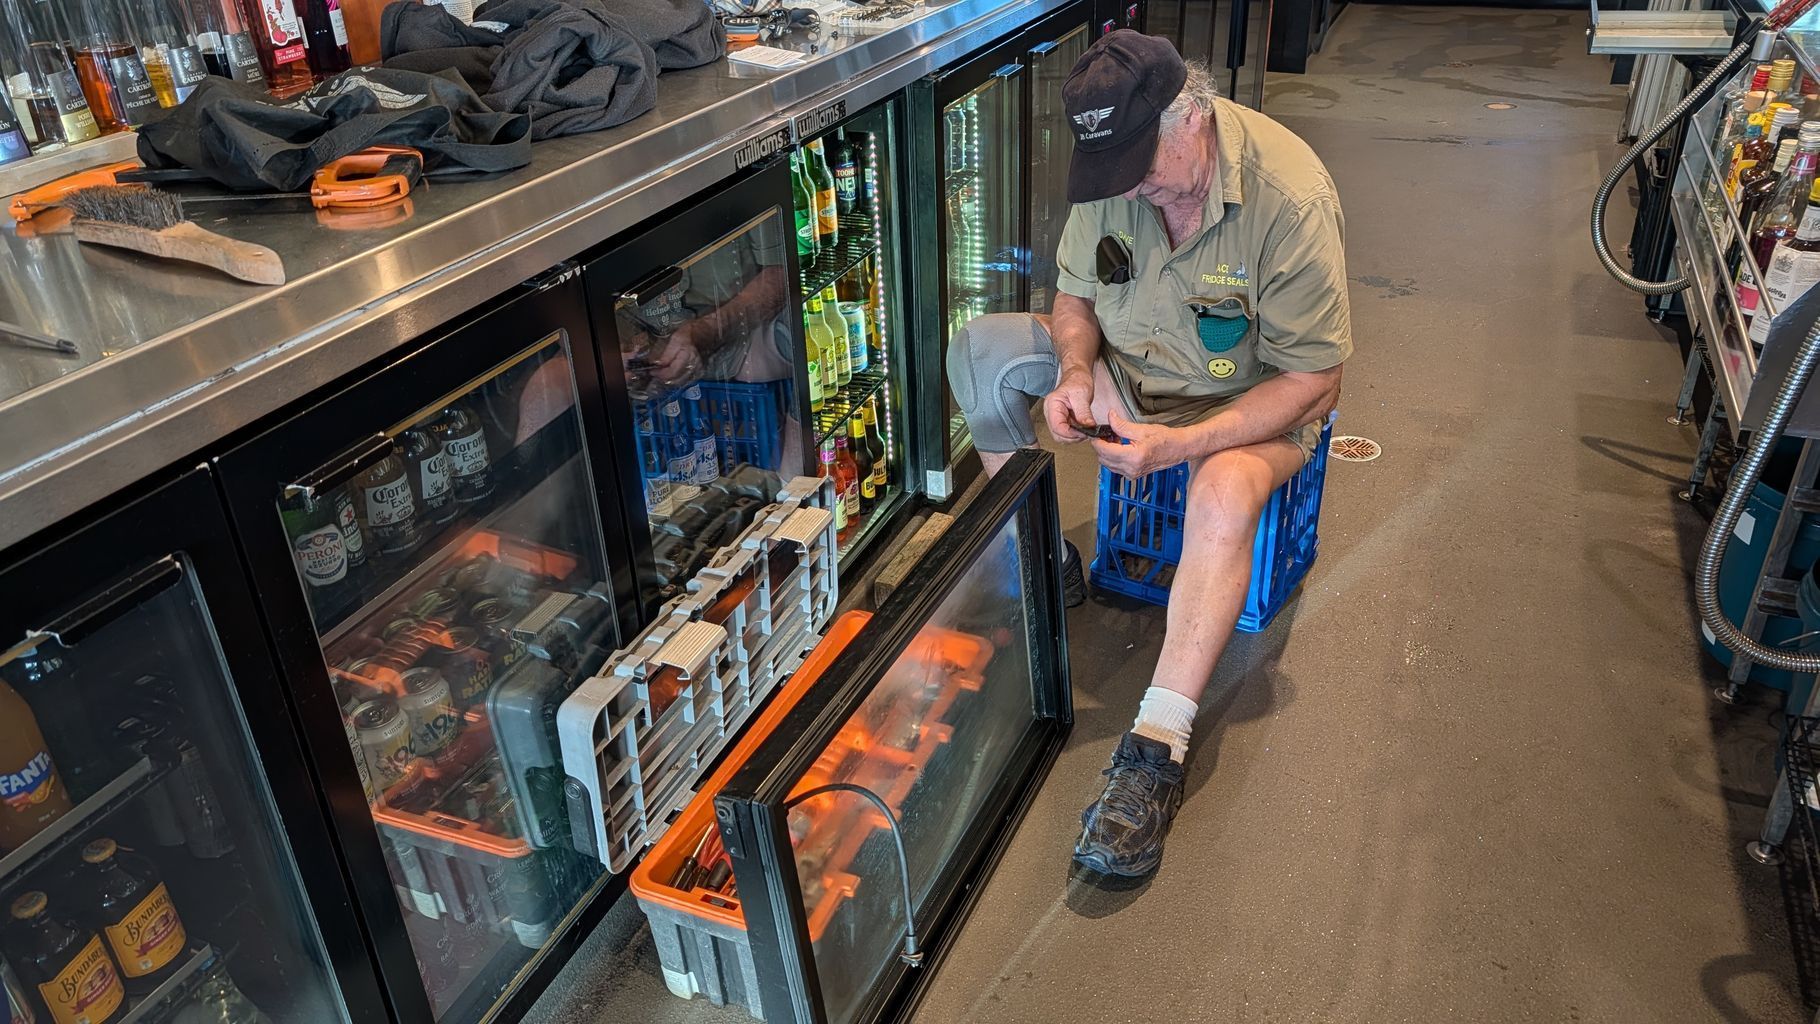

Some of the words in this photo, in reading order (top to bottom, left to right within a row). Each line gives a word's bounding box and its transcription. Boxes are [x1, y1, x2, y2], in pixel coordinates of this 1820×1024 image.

[798, 104, 840, 138] williams
[1086, 129, 1112, 139] Caravans
[735, 130, 784, 169] williams
[1201, 273, 1226, 285] FRIDGE
[1226, 277, 1249, 287] SEALS
[297, 539, 342, 561] PERONI
